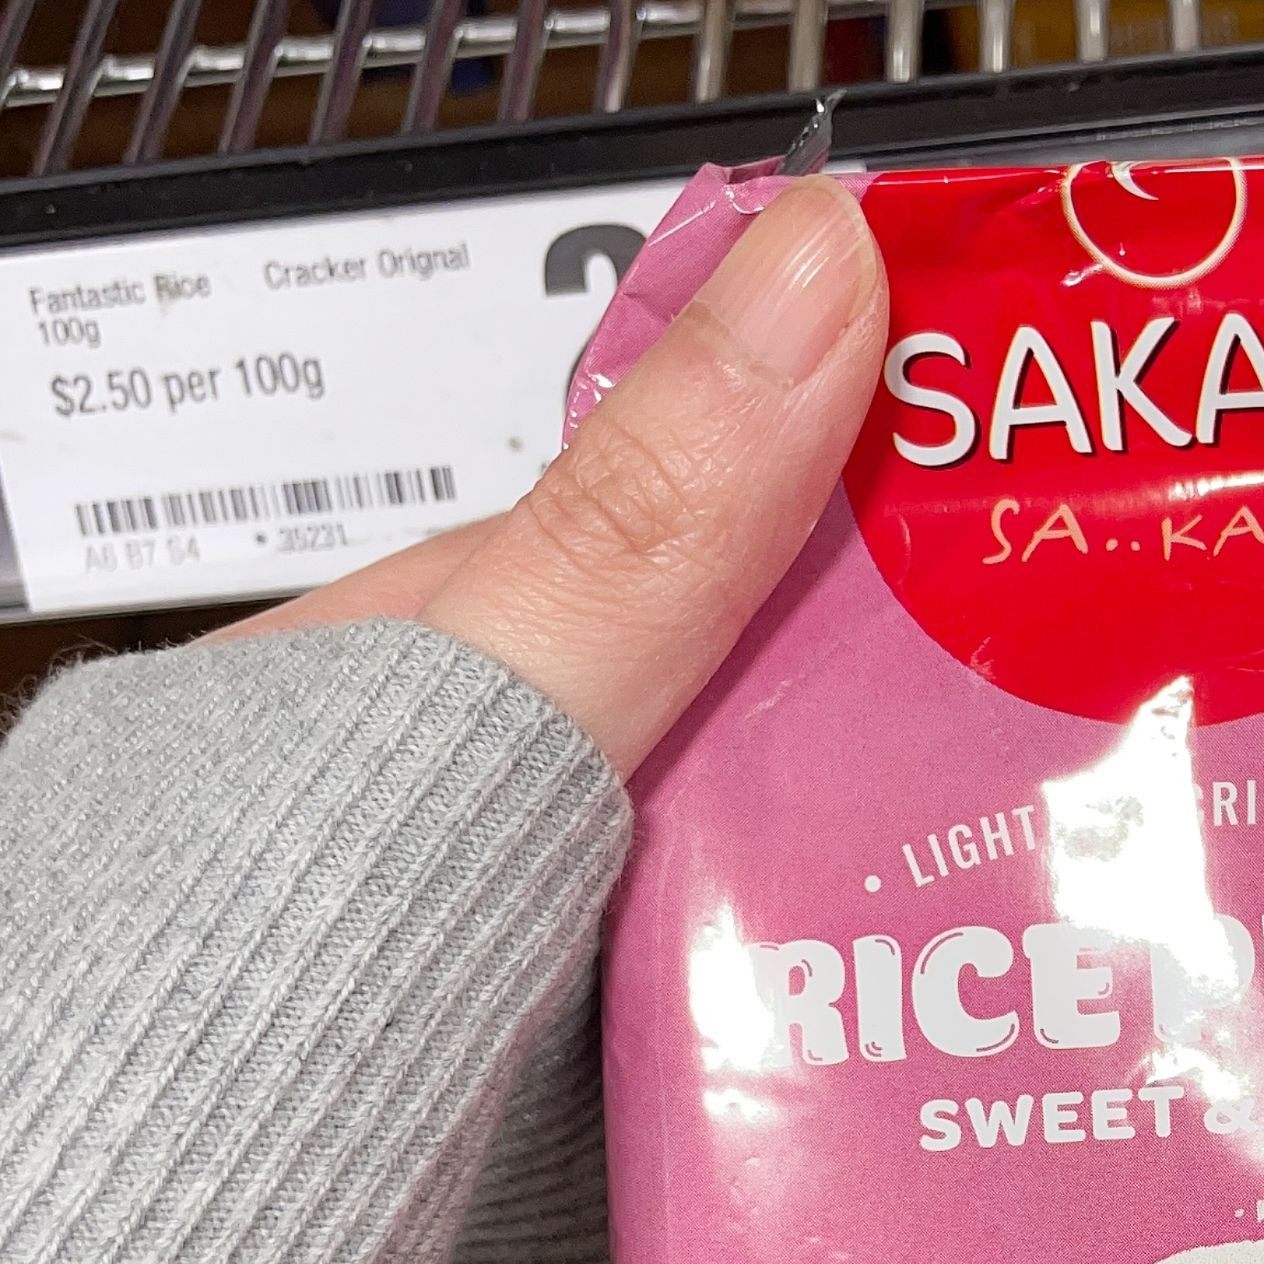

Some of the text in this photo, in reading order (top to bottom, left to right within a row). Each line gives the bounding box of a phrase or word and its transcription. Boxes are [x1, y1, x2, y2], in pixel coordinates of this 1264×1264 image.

[29, 242, 470, 315] Fantastic Rice Cracker Orignal
[38, 317, 101, 348] 100g
[51, 352, 325, 417] $2.50 per 100g
[901, 804, 1038, 888] LIGHT
[738, 922, 1123, 1067] RICE
[919, 1085, 1185, 1152] SWEET
